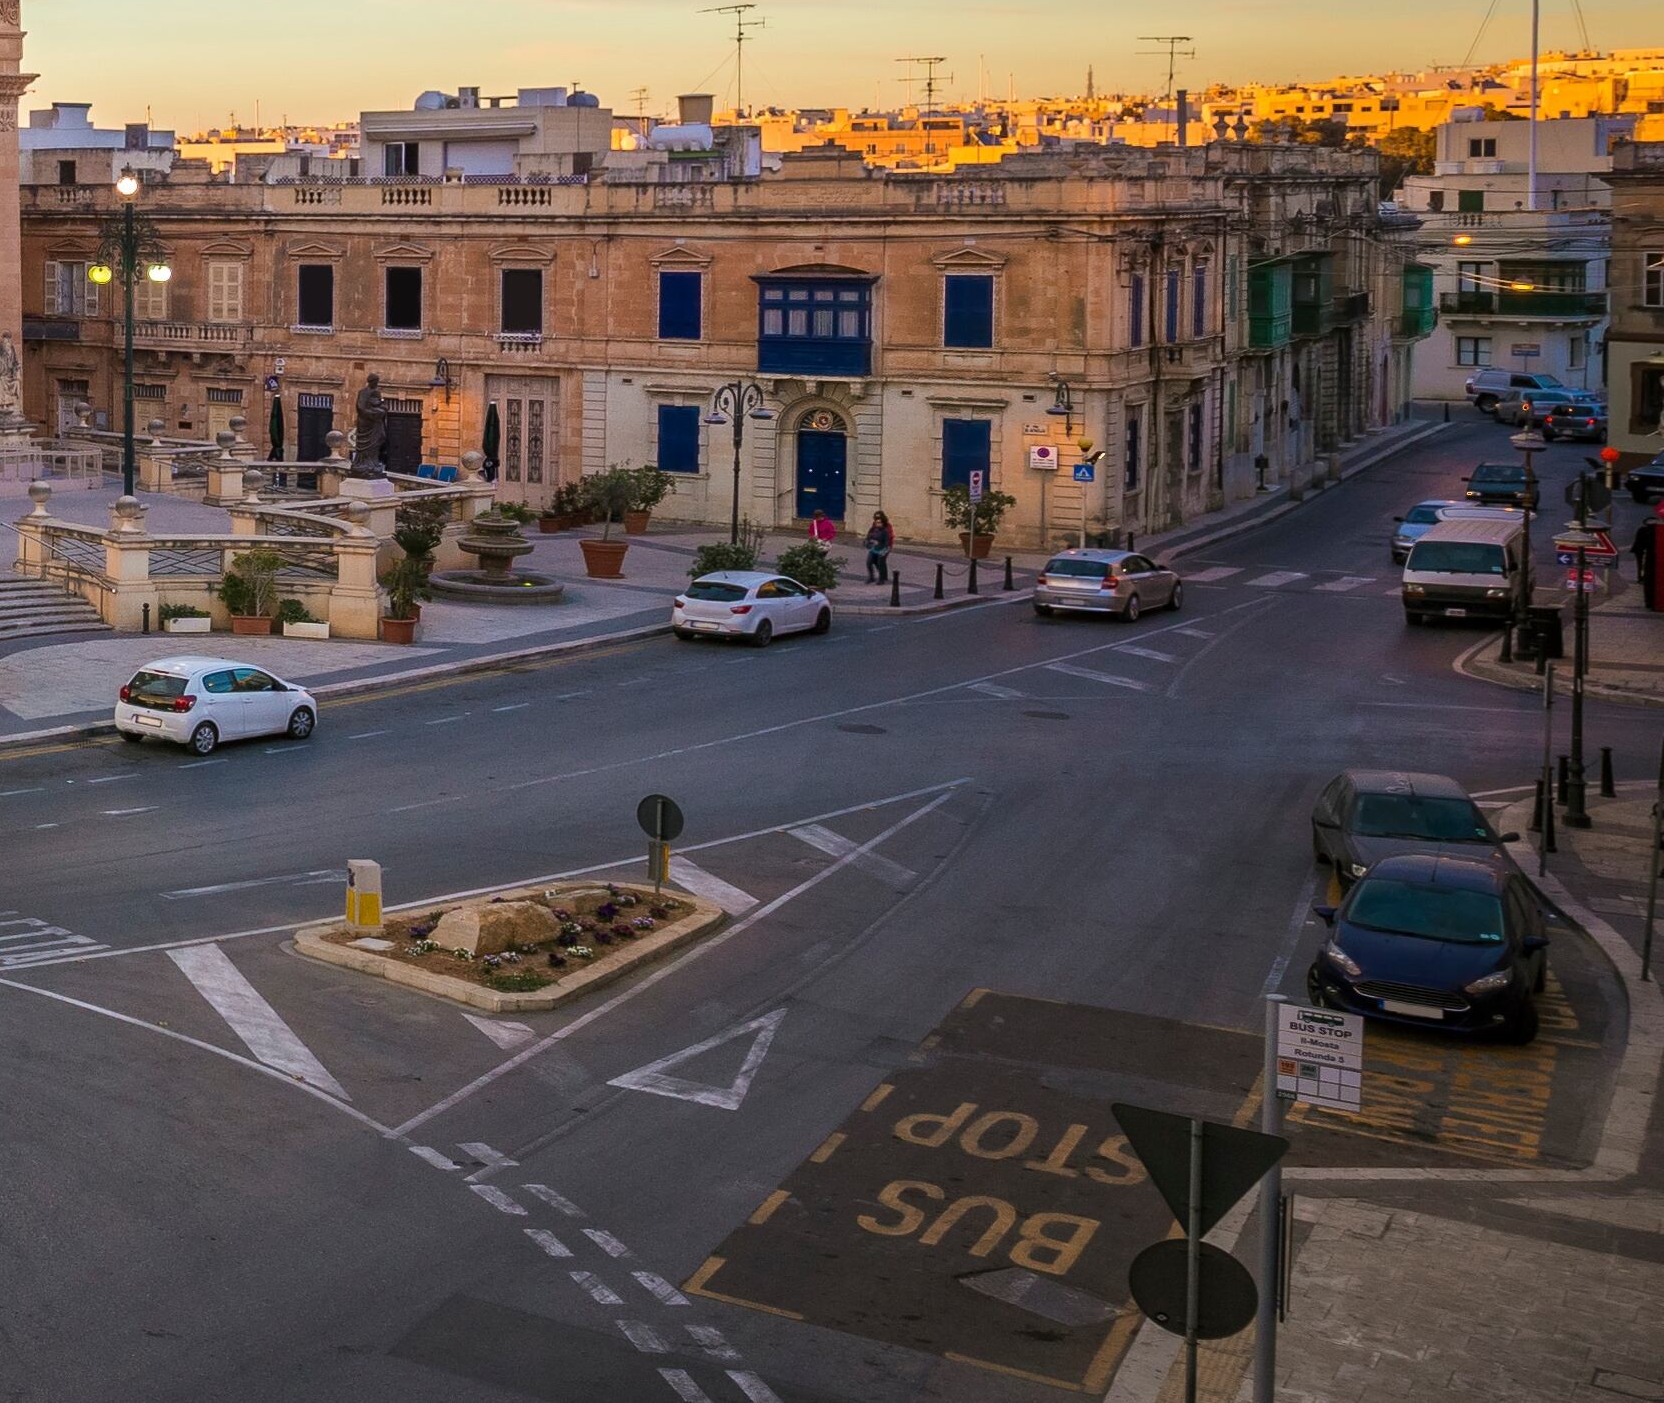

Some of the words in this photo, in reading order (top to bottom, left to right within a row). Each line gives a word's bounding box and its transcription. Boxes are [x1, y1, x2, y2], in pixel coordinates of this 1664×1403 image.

[1290, 1022, 1315, 1033] BUS
[1318, 1026, 1352, 1038] STOP
[1294, 1049, 1336, 1062] Rotunda
[893, 1102, 1148, 1185] STOP
[857, 1180, 1101, 1275] BUS
